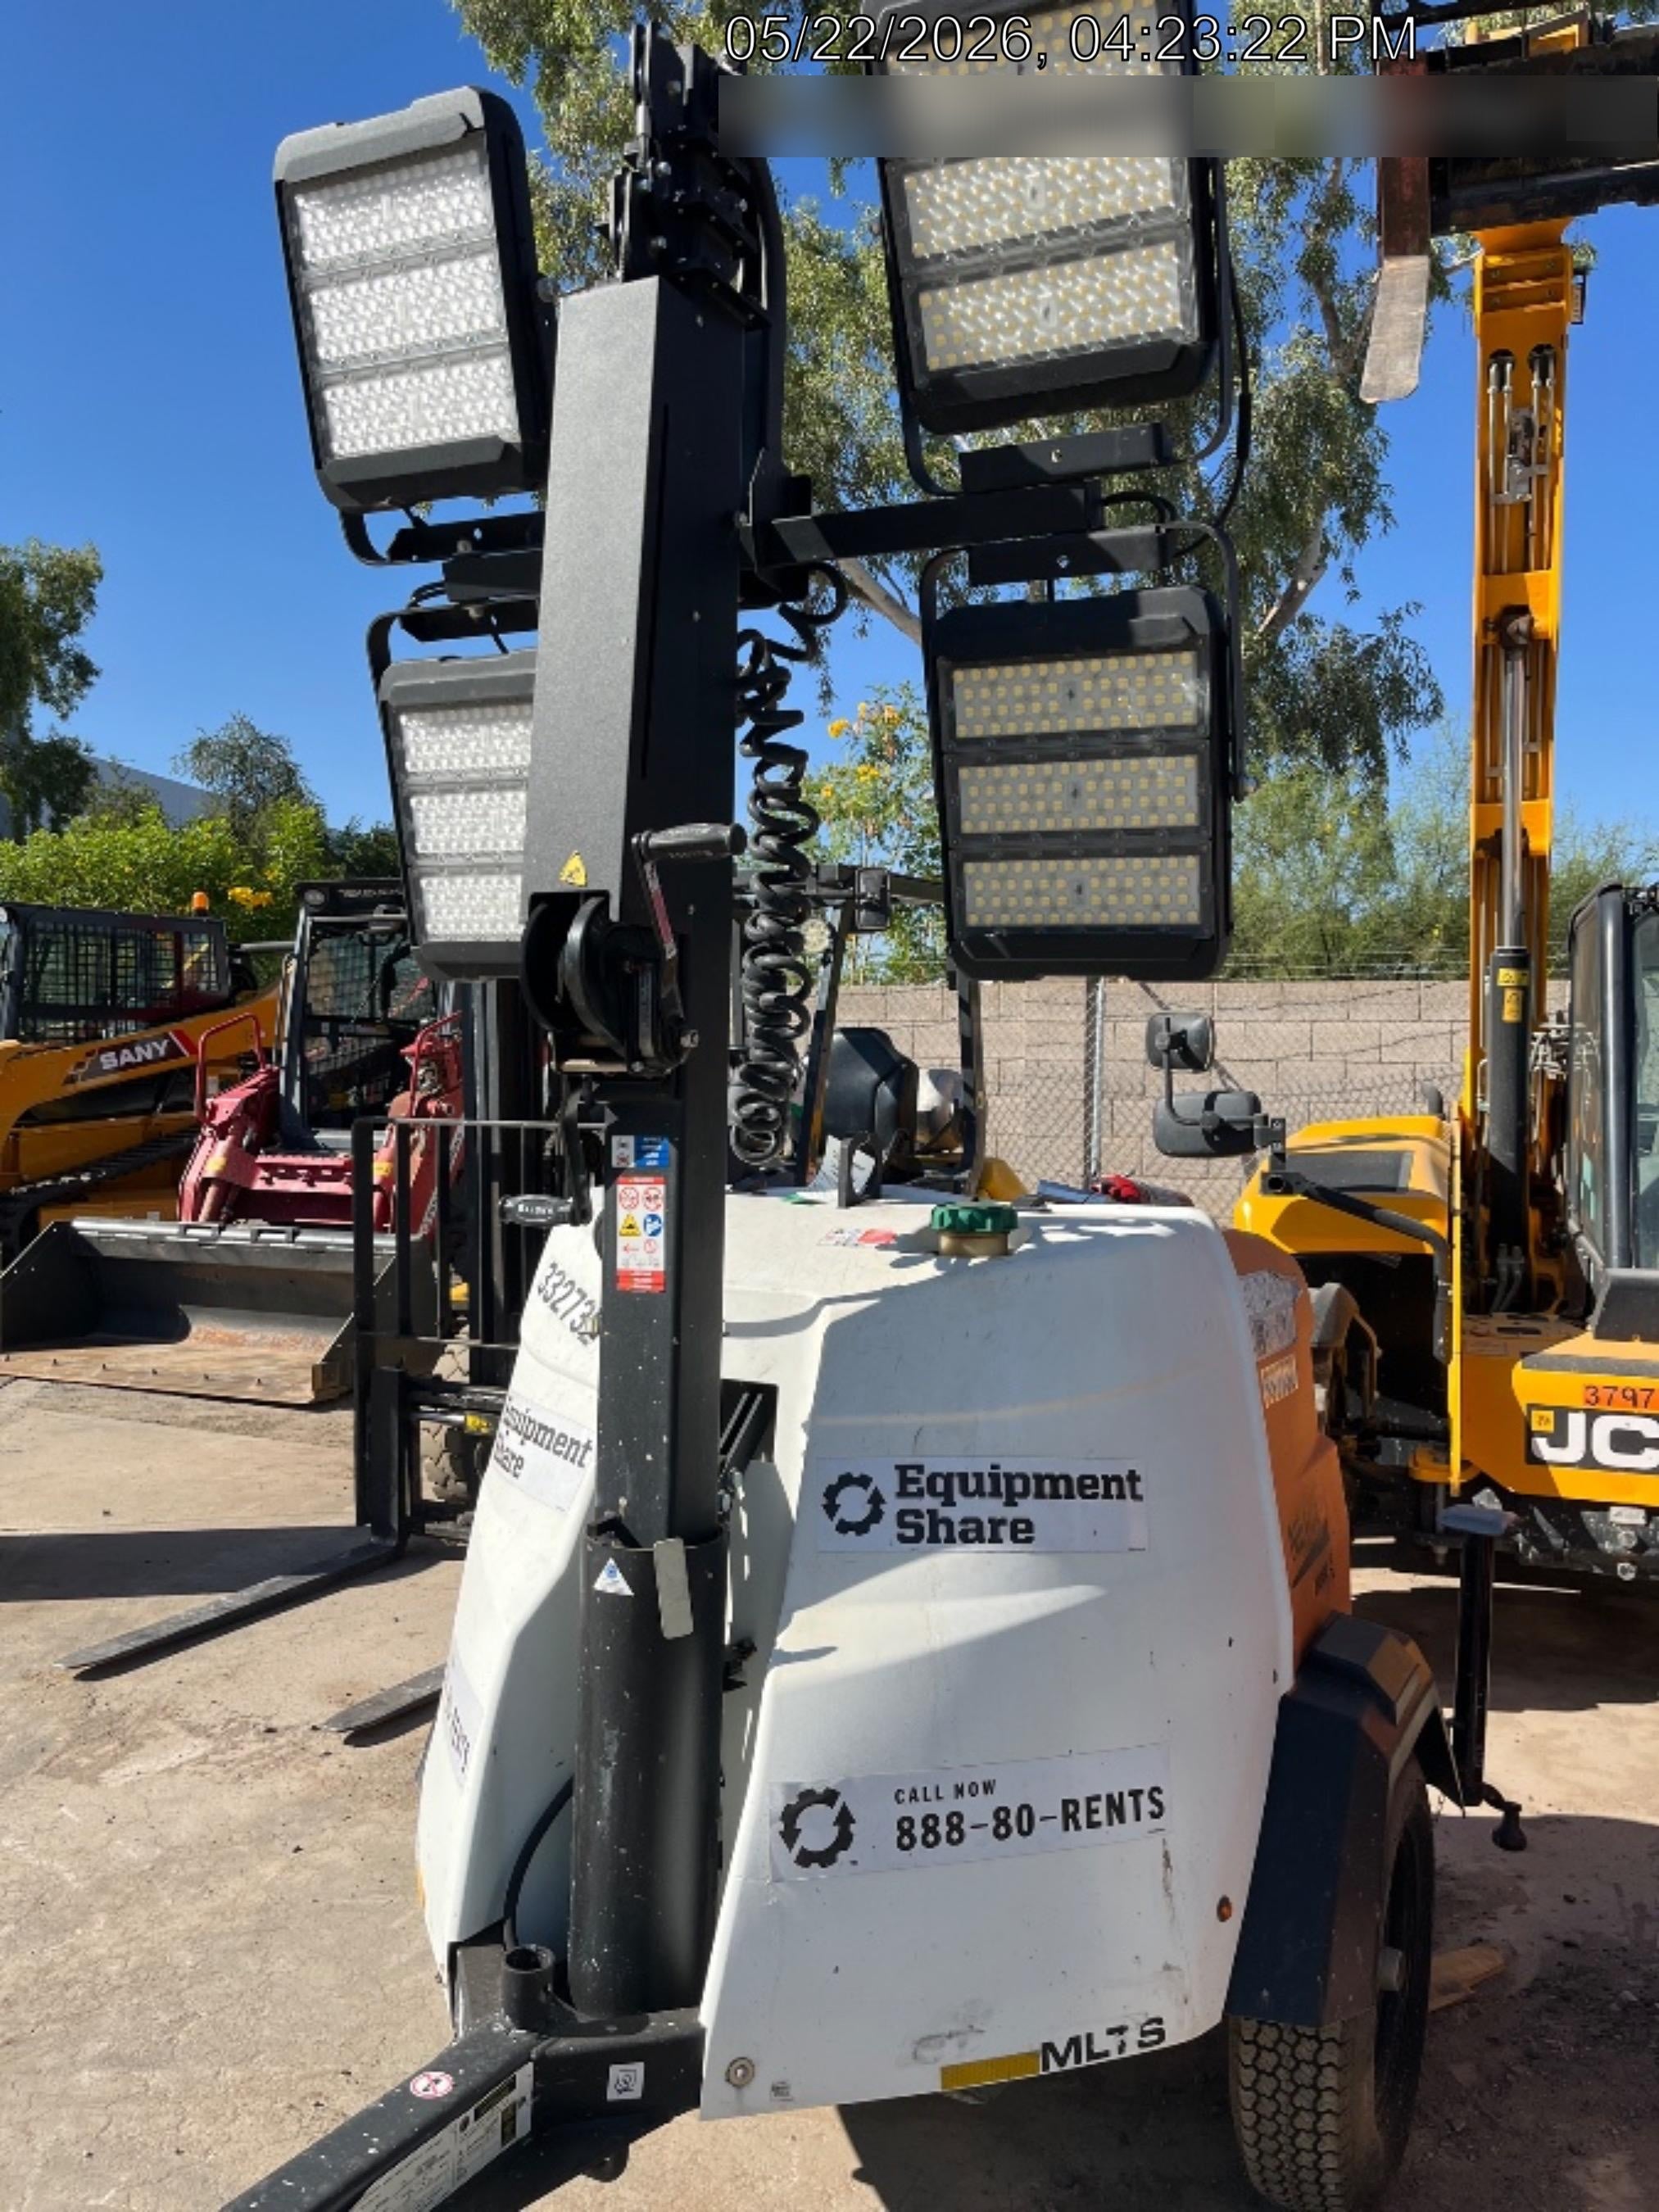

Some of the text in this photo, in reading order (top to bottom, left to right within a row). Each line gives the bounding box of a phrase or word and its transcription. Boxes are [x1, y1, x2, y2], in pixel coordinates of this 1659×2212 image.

[99, 1039, 170, 1070] SANY
[1584, 1385, 1656, 1409] 3797
[895, 1464, 1144, 1507] Equipment
[895, 1508, 1036, 1544] Share
[894, 1779, 997, 1805] CALL NOW
[895, 1786, 1166, 1852] 888-80-RENTS
